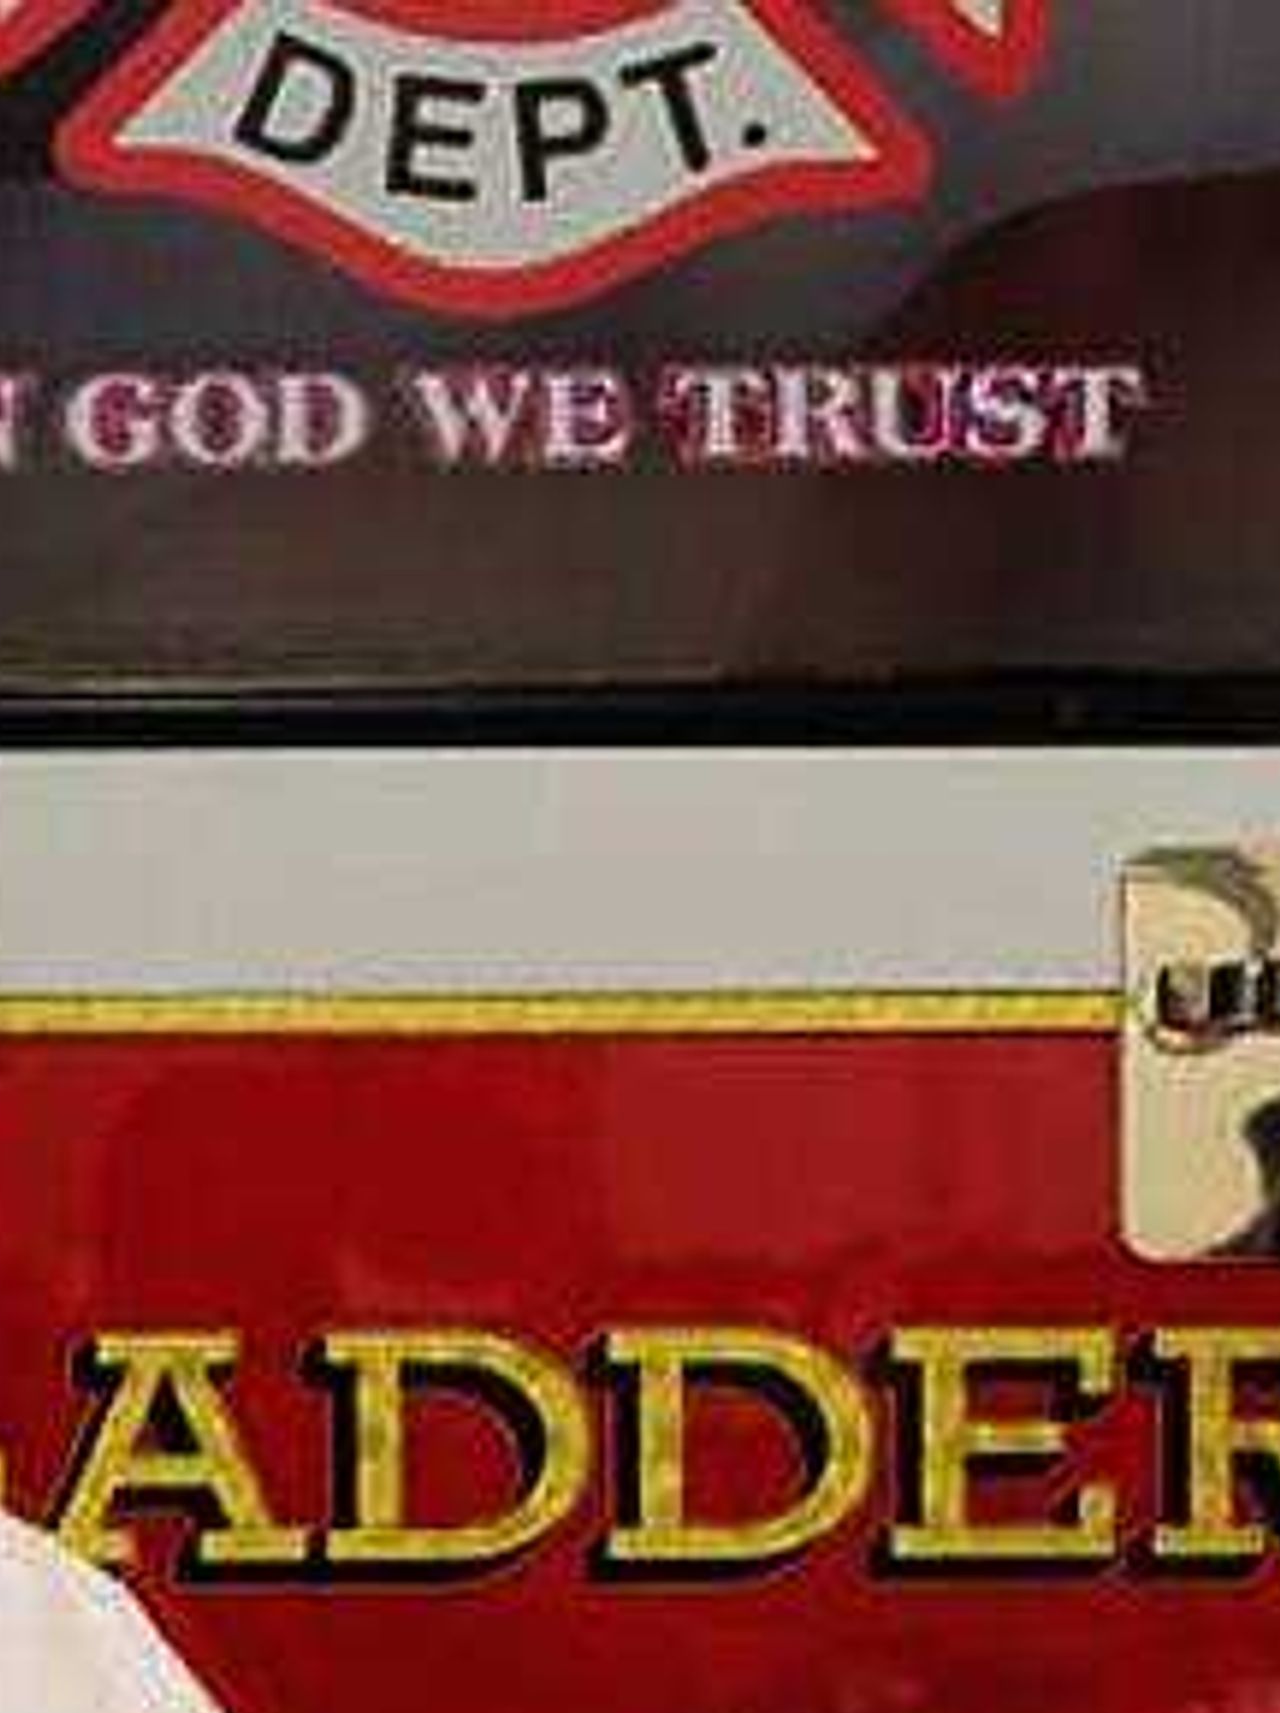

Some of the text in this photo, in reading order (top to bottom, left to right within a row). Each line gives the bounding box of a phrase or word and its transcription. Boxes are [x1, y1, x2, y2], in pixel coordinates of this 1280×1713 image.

[232, 32, 769, 202] DEPT.
[65, 372, 365, 468] GOD
[414, 370, 625, 466] WE
[675, 364, 1138, 462] TRUST
